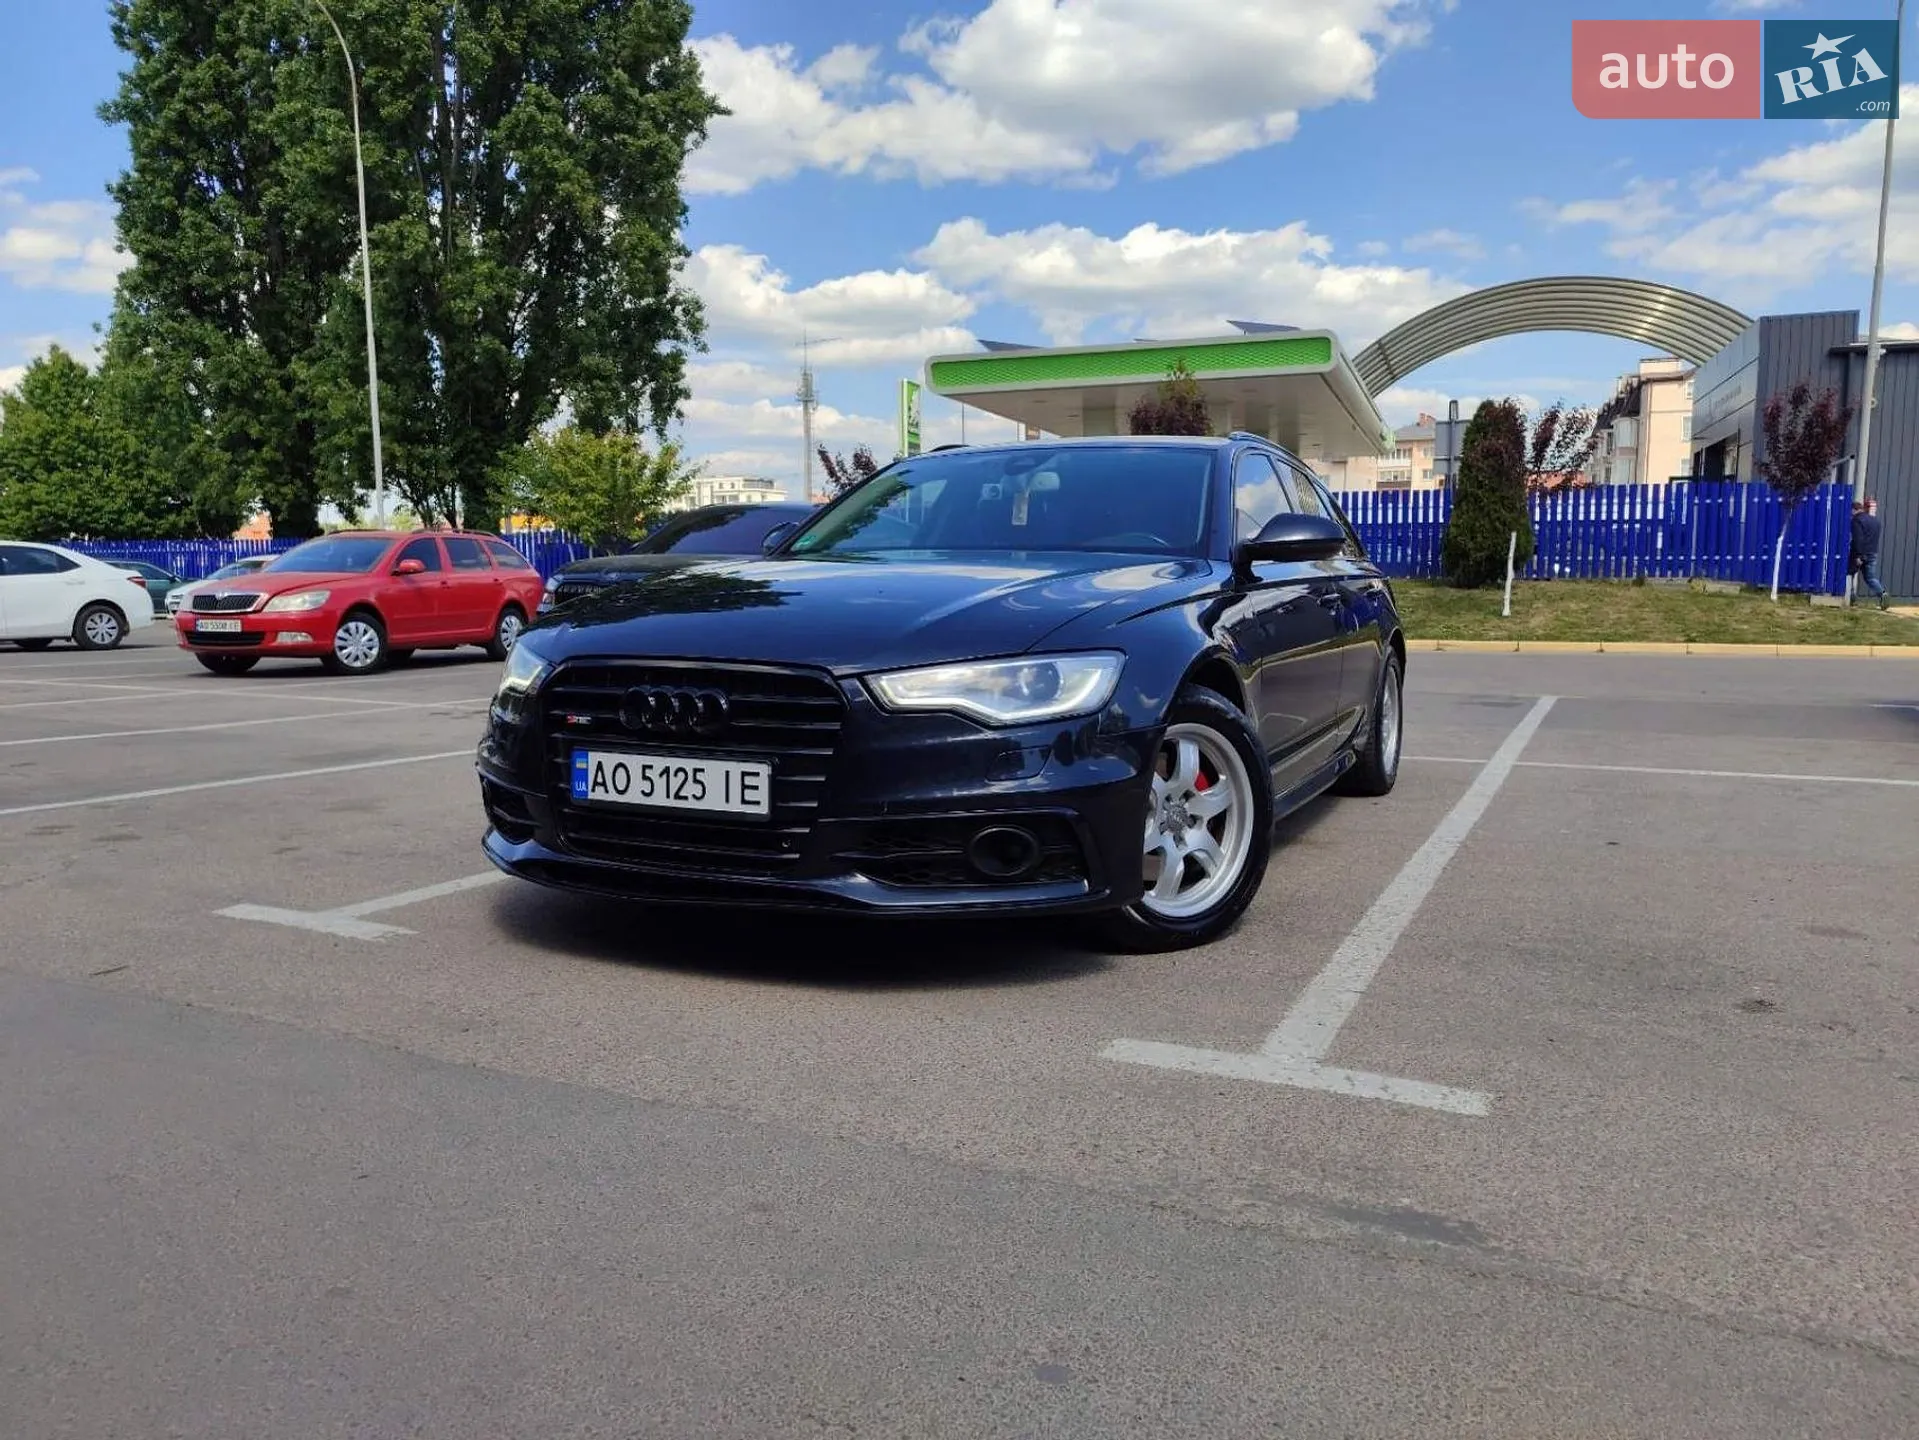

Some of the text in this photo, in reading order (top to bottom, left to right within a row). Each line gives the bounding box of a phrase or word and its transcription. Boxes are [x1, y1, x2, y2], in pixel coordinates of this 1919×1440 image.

[575, 781, 588, 792] UA
[591, 760, 761, 806] AO 5125 IE
